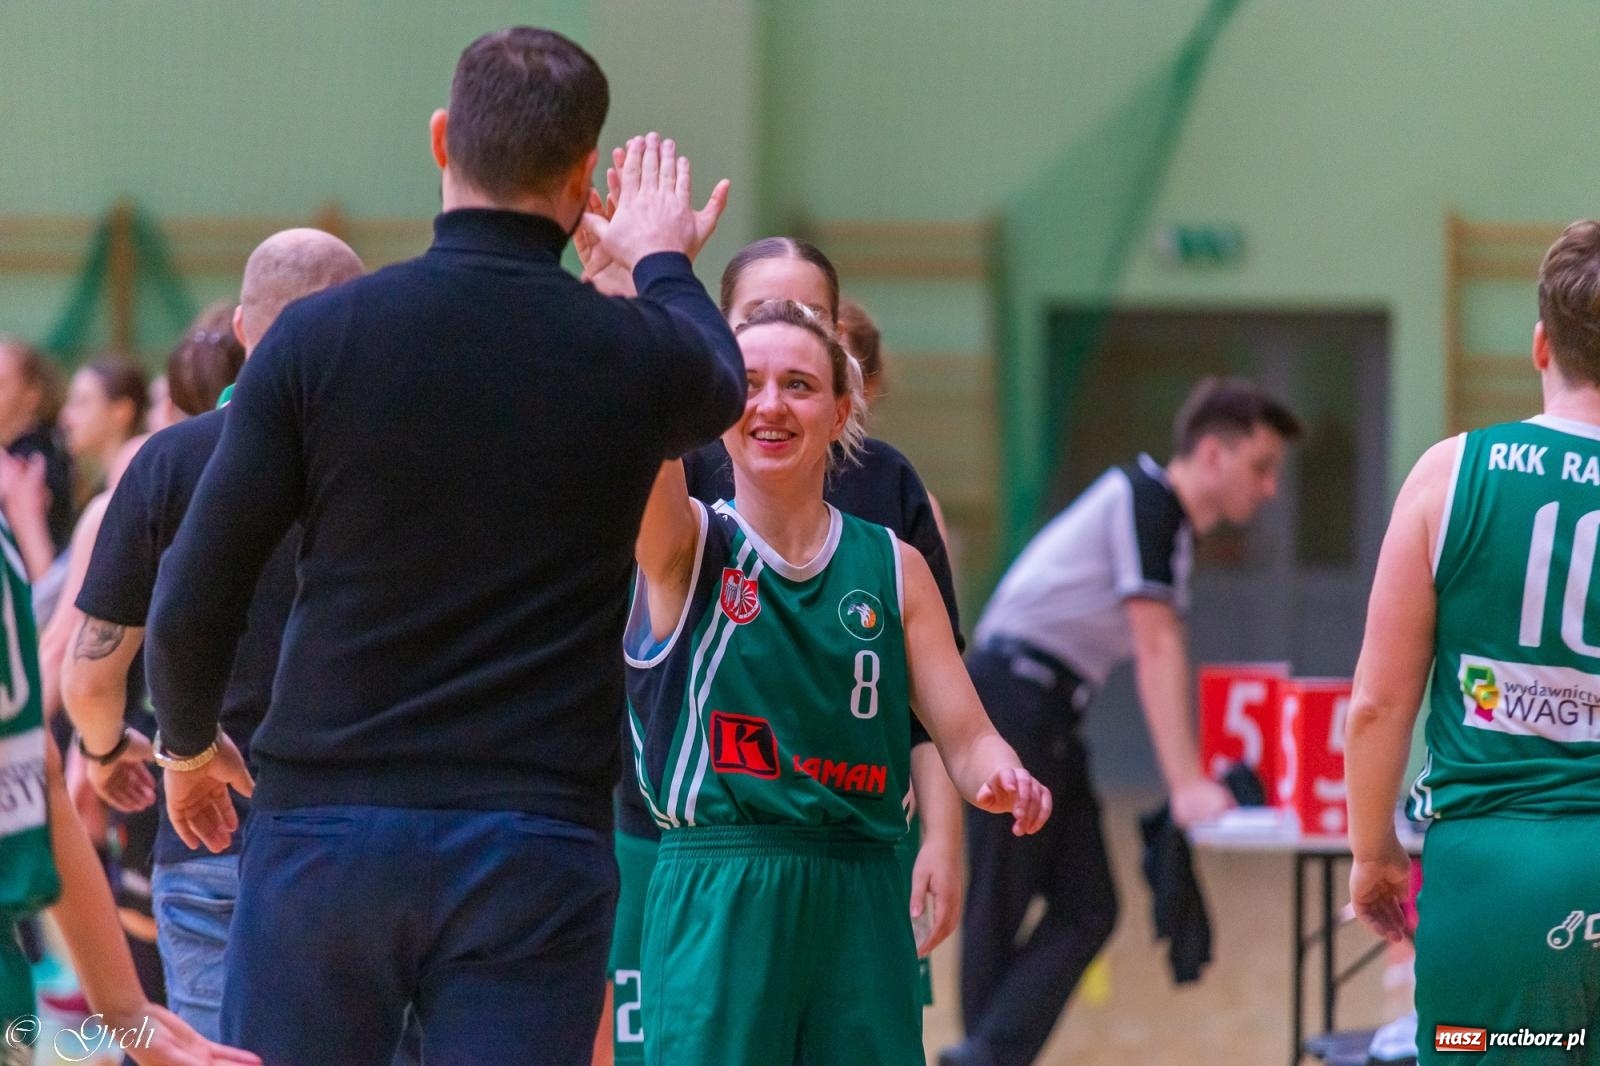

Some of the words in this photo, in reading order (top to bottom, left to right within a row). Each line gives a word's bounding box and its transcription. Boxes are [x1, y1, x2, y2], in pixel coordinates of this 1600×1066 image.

[1488, 442, 1549, 476] RKK
[850, 650, 880, 720] 8
[615, 969, 644, 1043] 2
